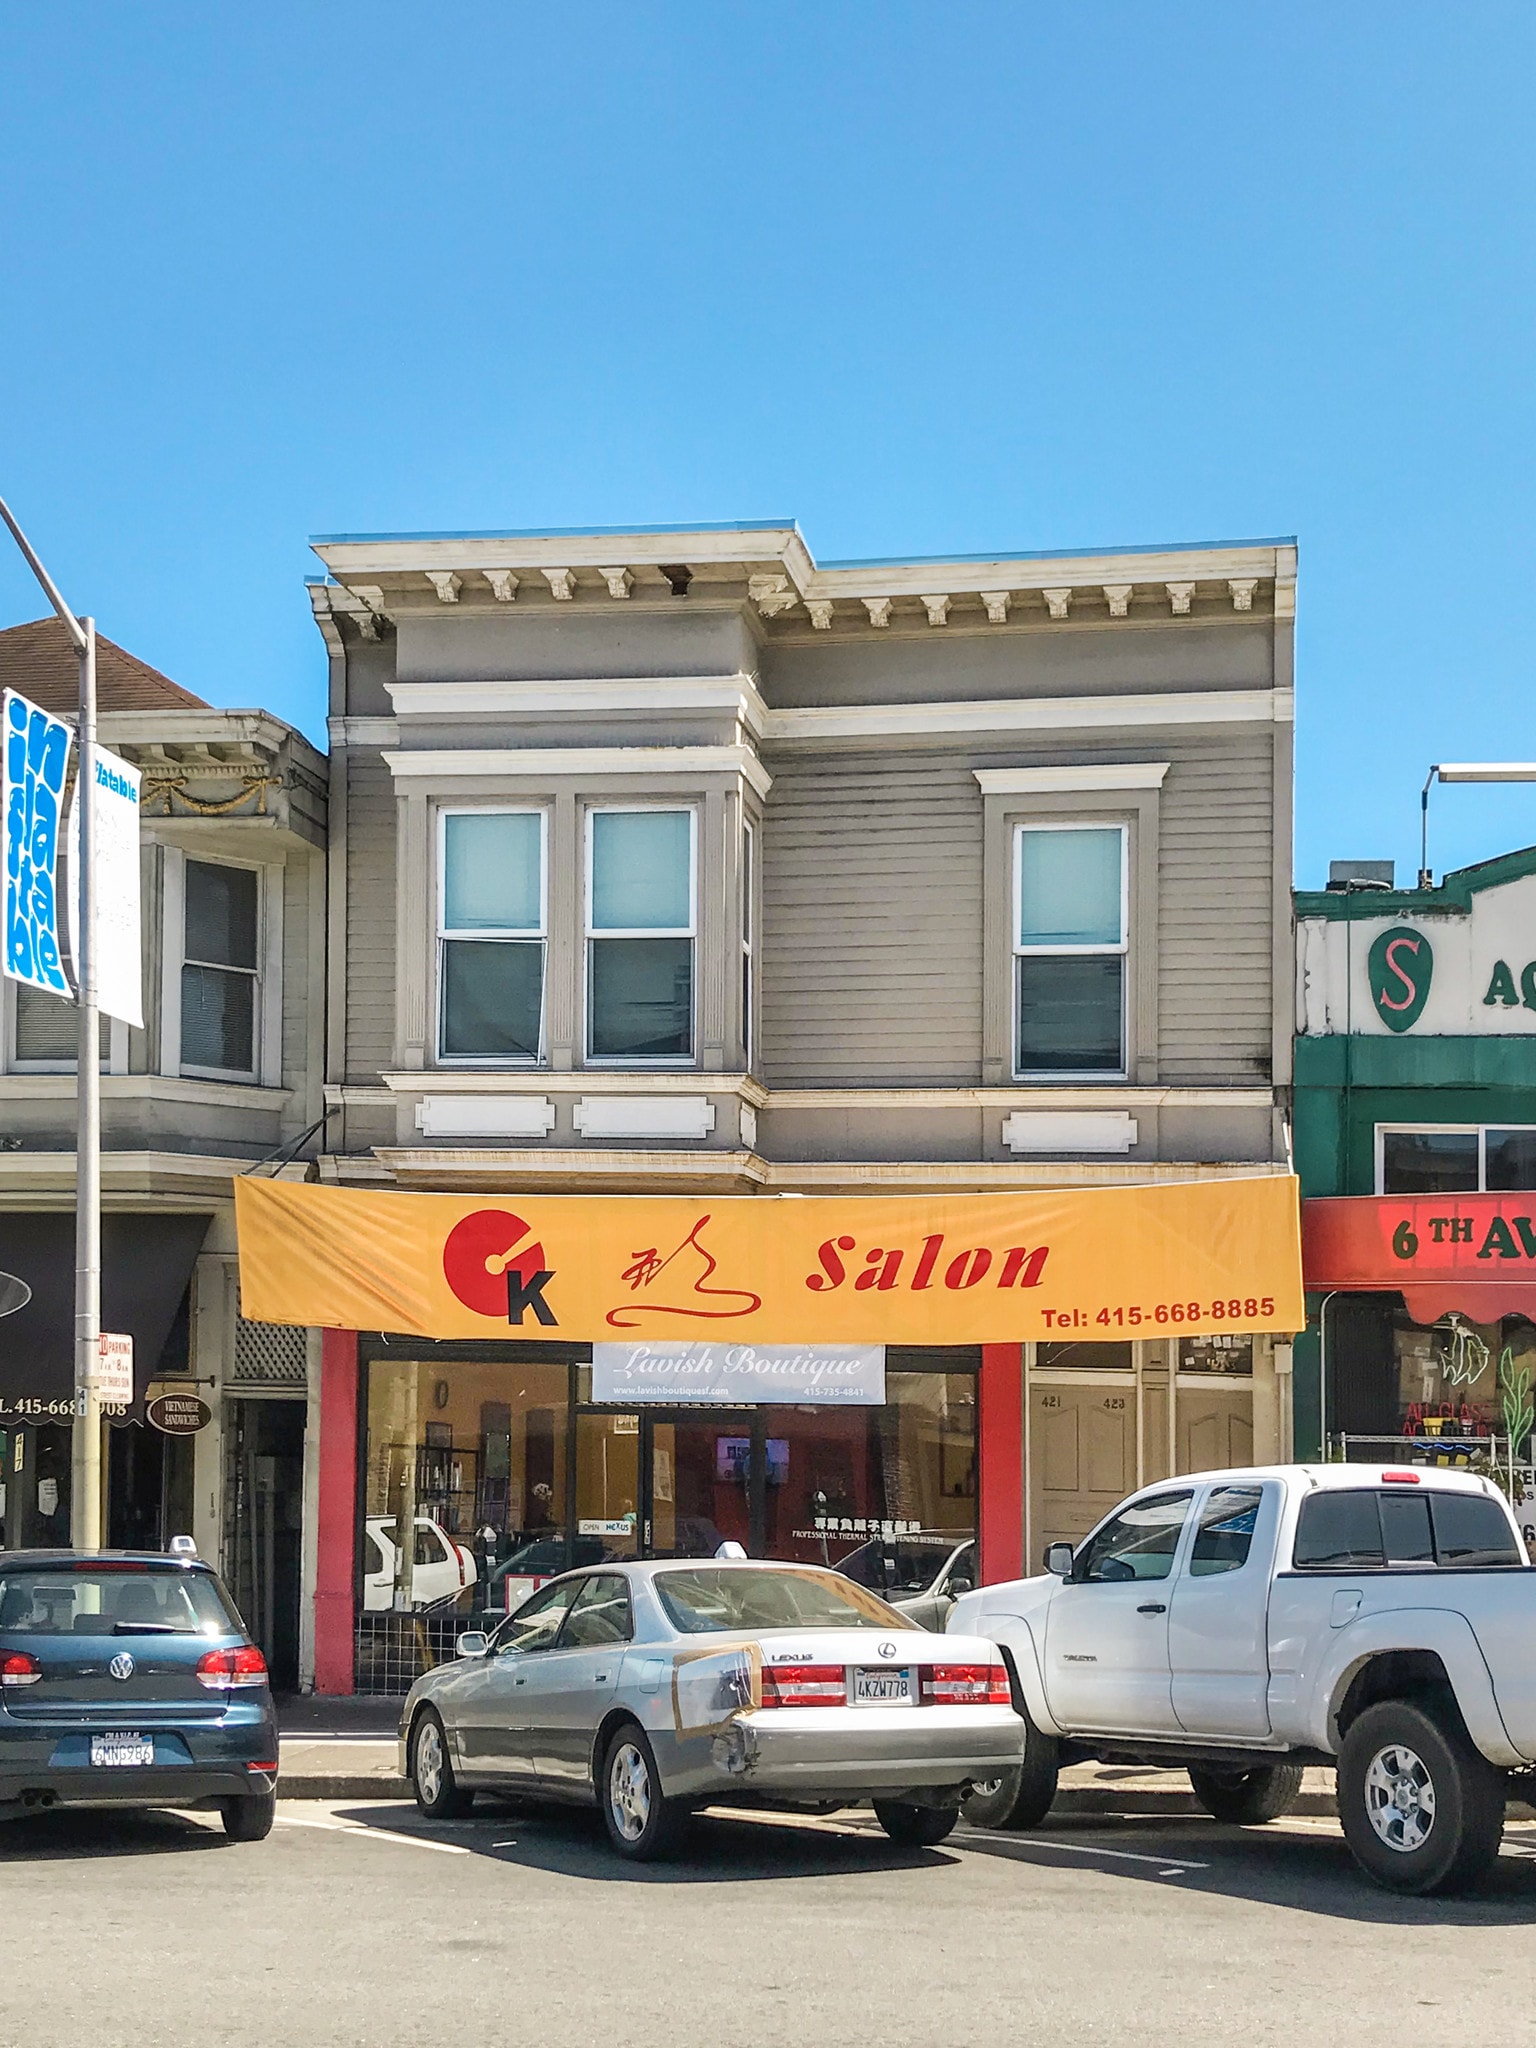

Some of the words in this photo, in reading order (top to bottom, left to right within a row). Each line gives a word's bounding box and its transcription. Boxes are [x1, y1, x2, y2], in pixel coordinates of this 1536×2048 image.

[805, 1233, 1050, 1293] Salon
[1041, 1308, 1087, 1328] Tel:
[1096, 1297, 1275, 1327] 415-668-8885
[108, 1341, 131, 1355] PARKING
[613, 1346, 714, 1379] Lavish
[723, 1346, 865, 1385] Boutique
[804, 1387, 864, 1398] 415-735-4841
[164, 1401, 200, 1412] VIETNAMESE
[1041, 1395, 1061, 1408] 421
[1103, 1397, 1125, 1410] 423
[164, 1413, 200, 1426] SANDWICHES
[605, 1521, 629, 1532] NEXUS
[838, 1533, 868, 1541] THERMAL
[772, 1653, 814, 1662] LEXUS
[858, 1680, 909, 1698] 4KZW778
[95, 1745, 151, 1761] 6MNG986
